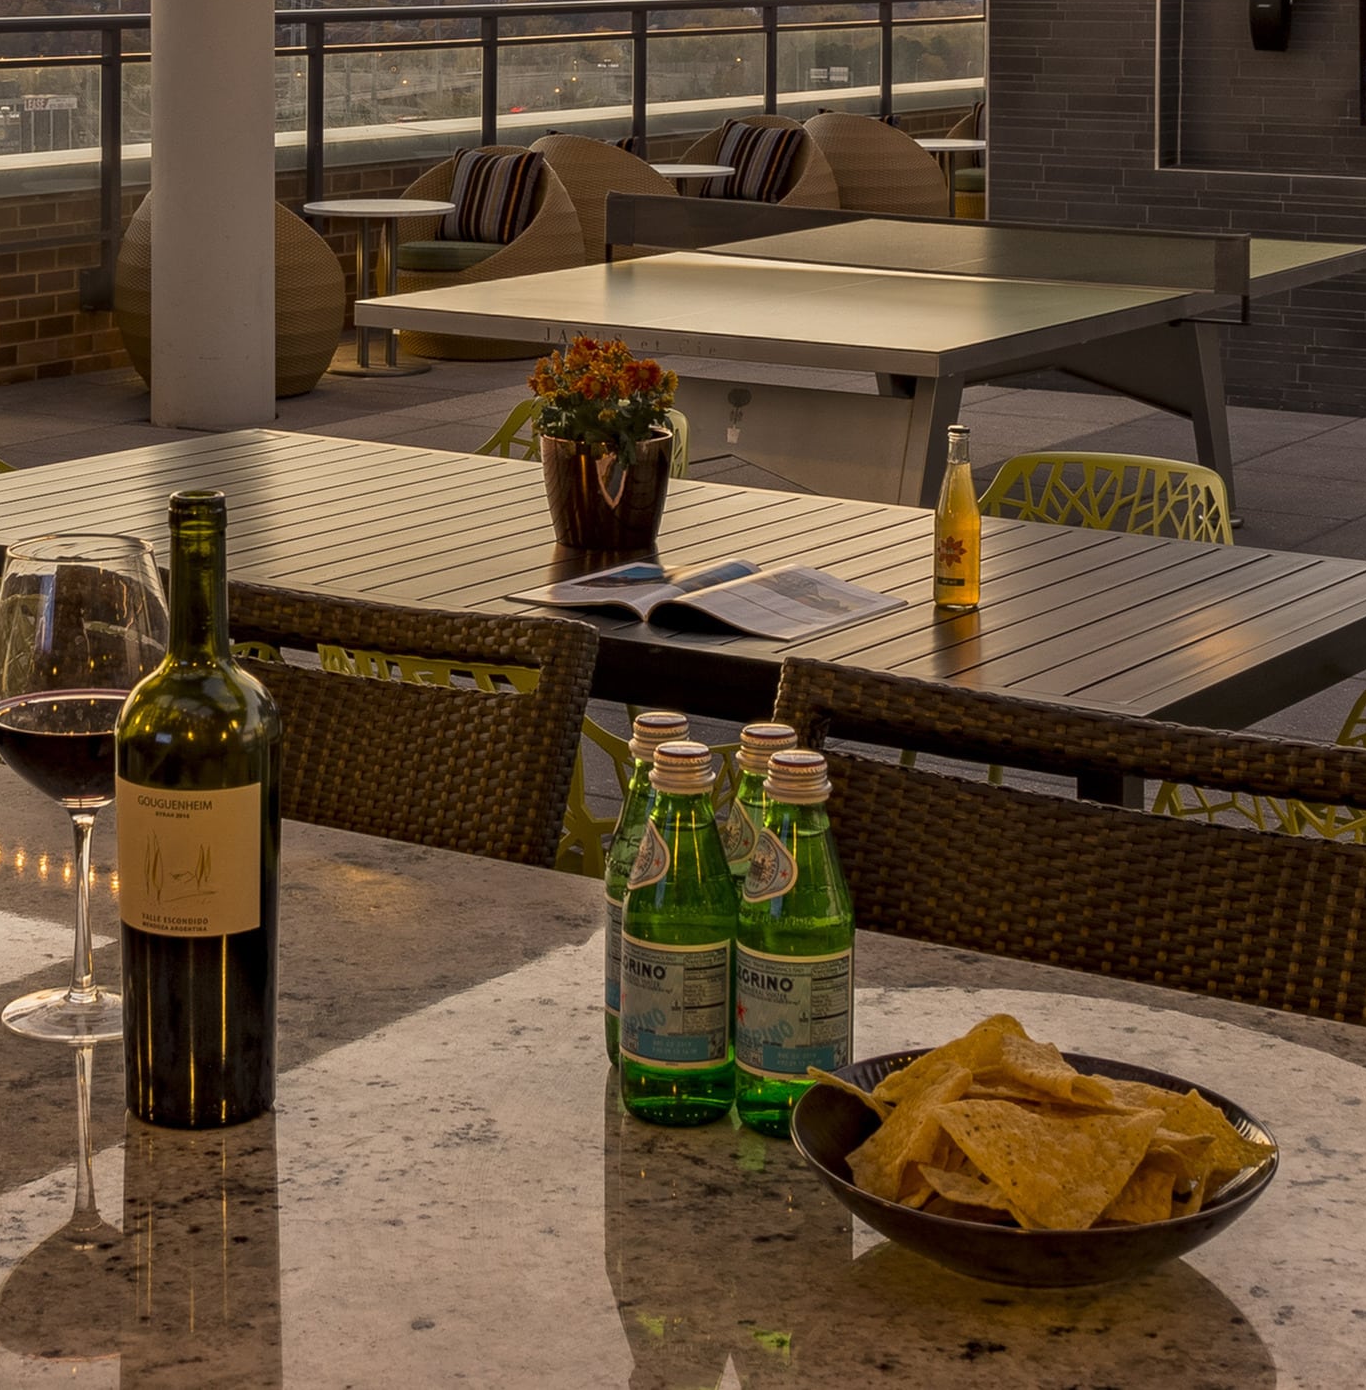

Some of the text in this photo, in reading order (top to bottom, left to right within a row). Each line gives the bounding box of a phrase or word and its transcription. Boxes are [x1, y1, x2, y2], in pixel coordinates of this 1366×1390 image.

[641, 339, 660, 351] et
[137, 794, 213, 811] GOUGUENHEIM
[142, 912, 209, 925] VALLE ESCONDIDO
[142, 921, 169, 930] MENDOZA
